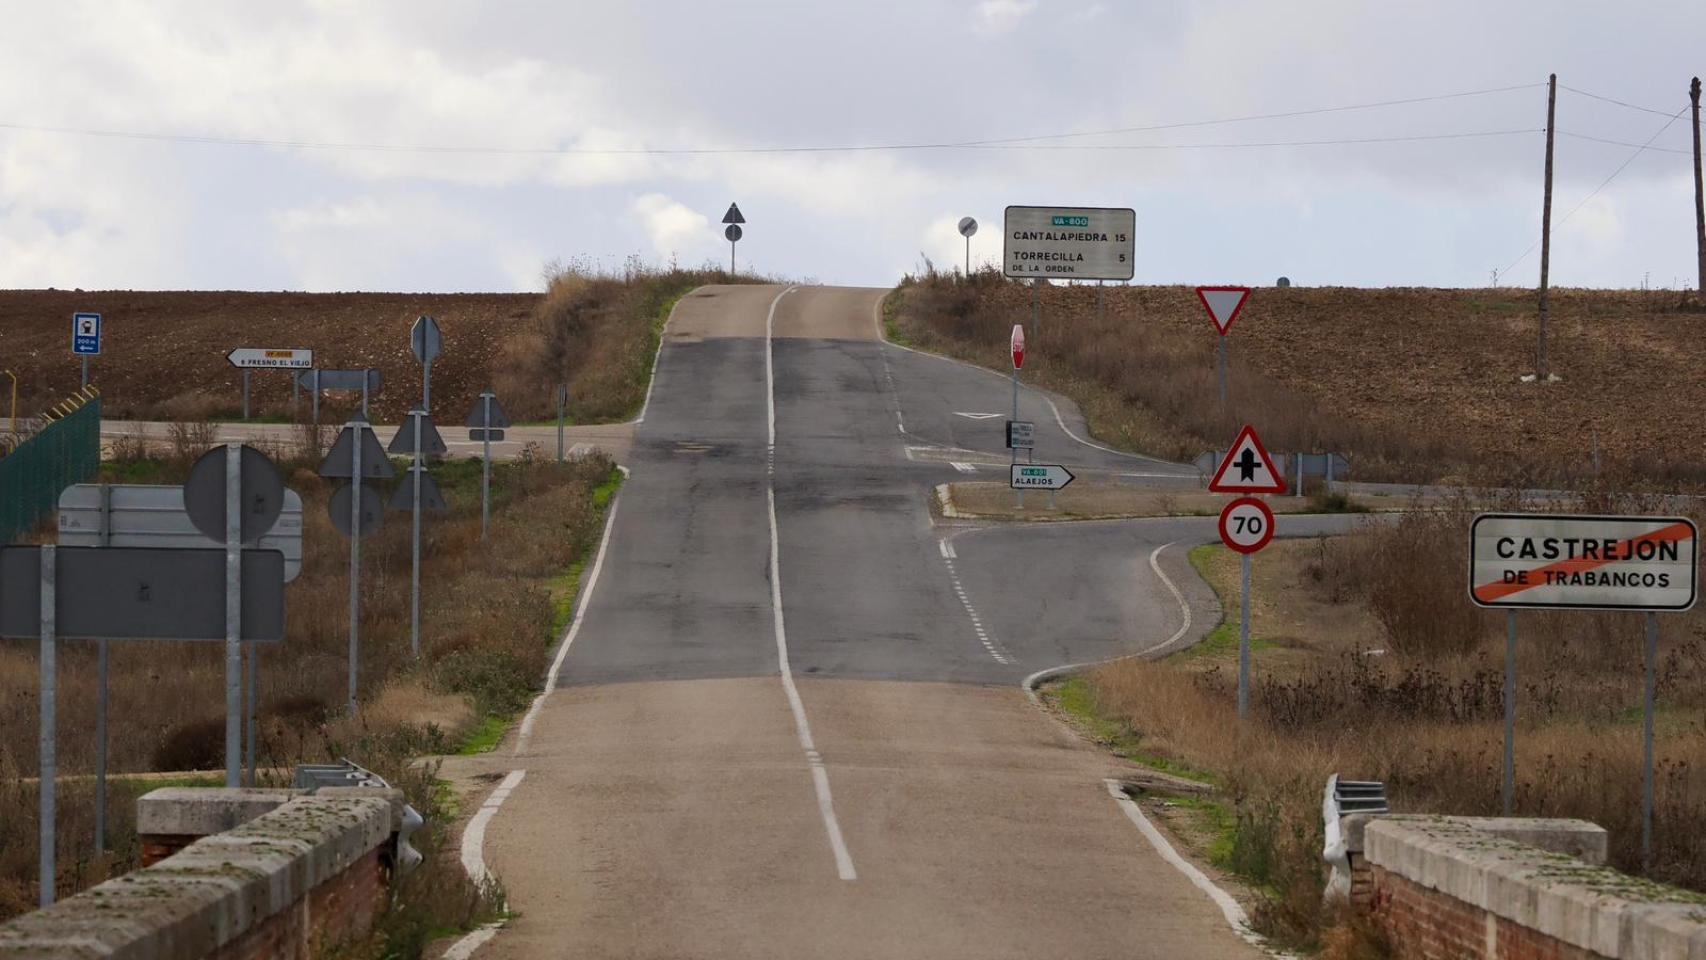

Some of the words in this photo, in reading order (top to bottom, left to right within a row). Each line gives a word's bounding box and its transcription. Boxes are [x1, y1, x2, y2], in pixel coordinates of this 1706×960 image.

[1054, 217, 1087, 226] VA-800
[1013, 231, 1108, 242] CANTALAPIEDRA
[1115, 234, 1126, 242] 15
[1013, 251, 1084, 262] TORRECILLA
[1119, 254, 1126, 263] 5
[1012, 264, 1024, 272] DE
[1028, 264, 1040, 272] LA
[1045, 265, 1074, 273] ORDEN
[1233, 516, 1262, 535] 70
[1496, 537, 1679, 562] CASTREJON
[1503, 569, 1529, 585] DE
[1543, 570, 1670, 588] TRABANCOS
